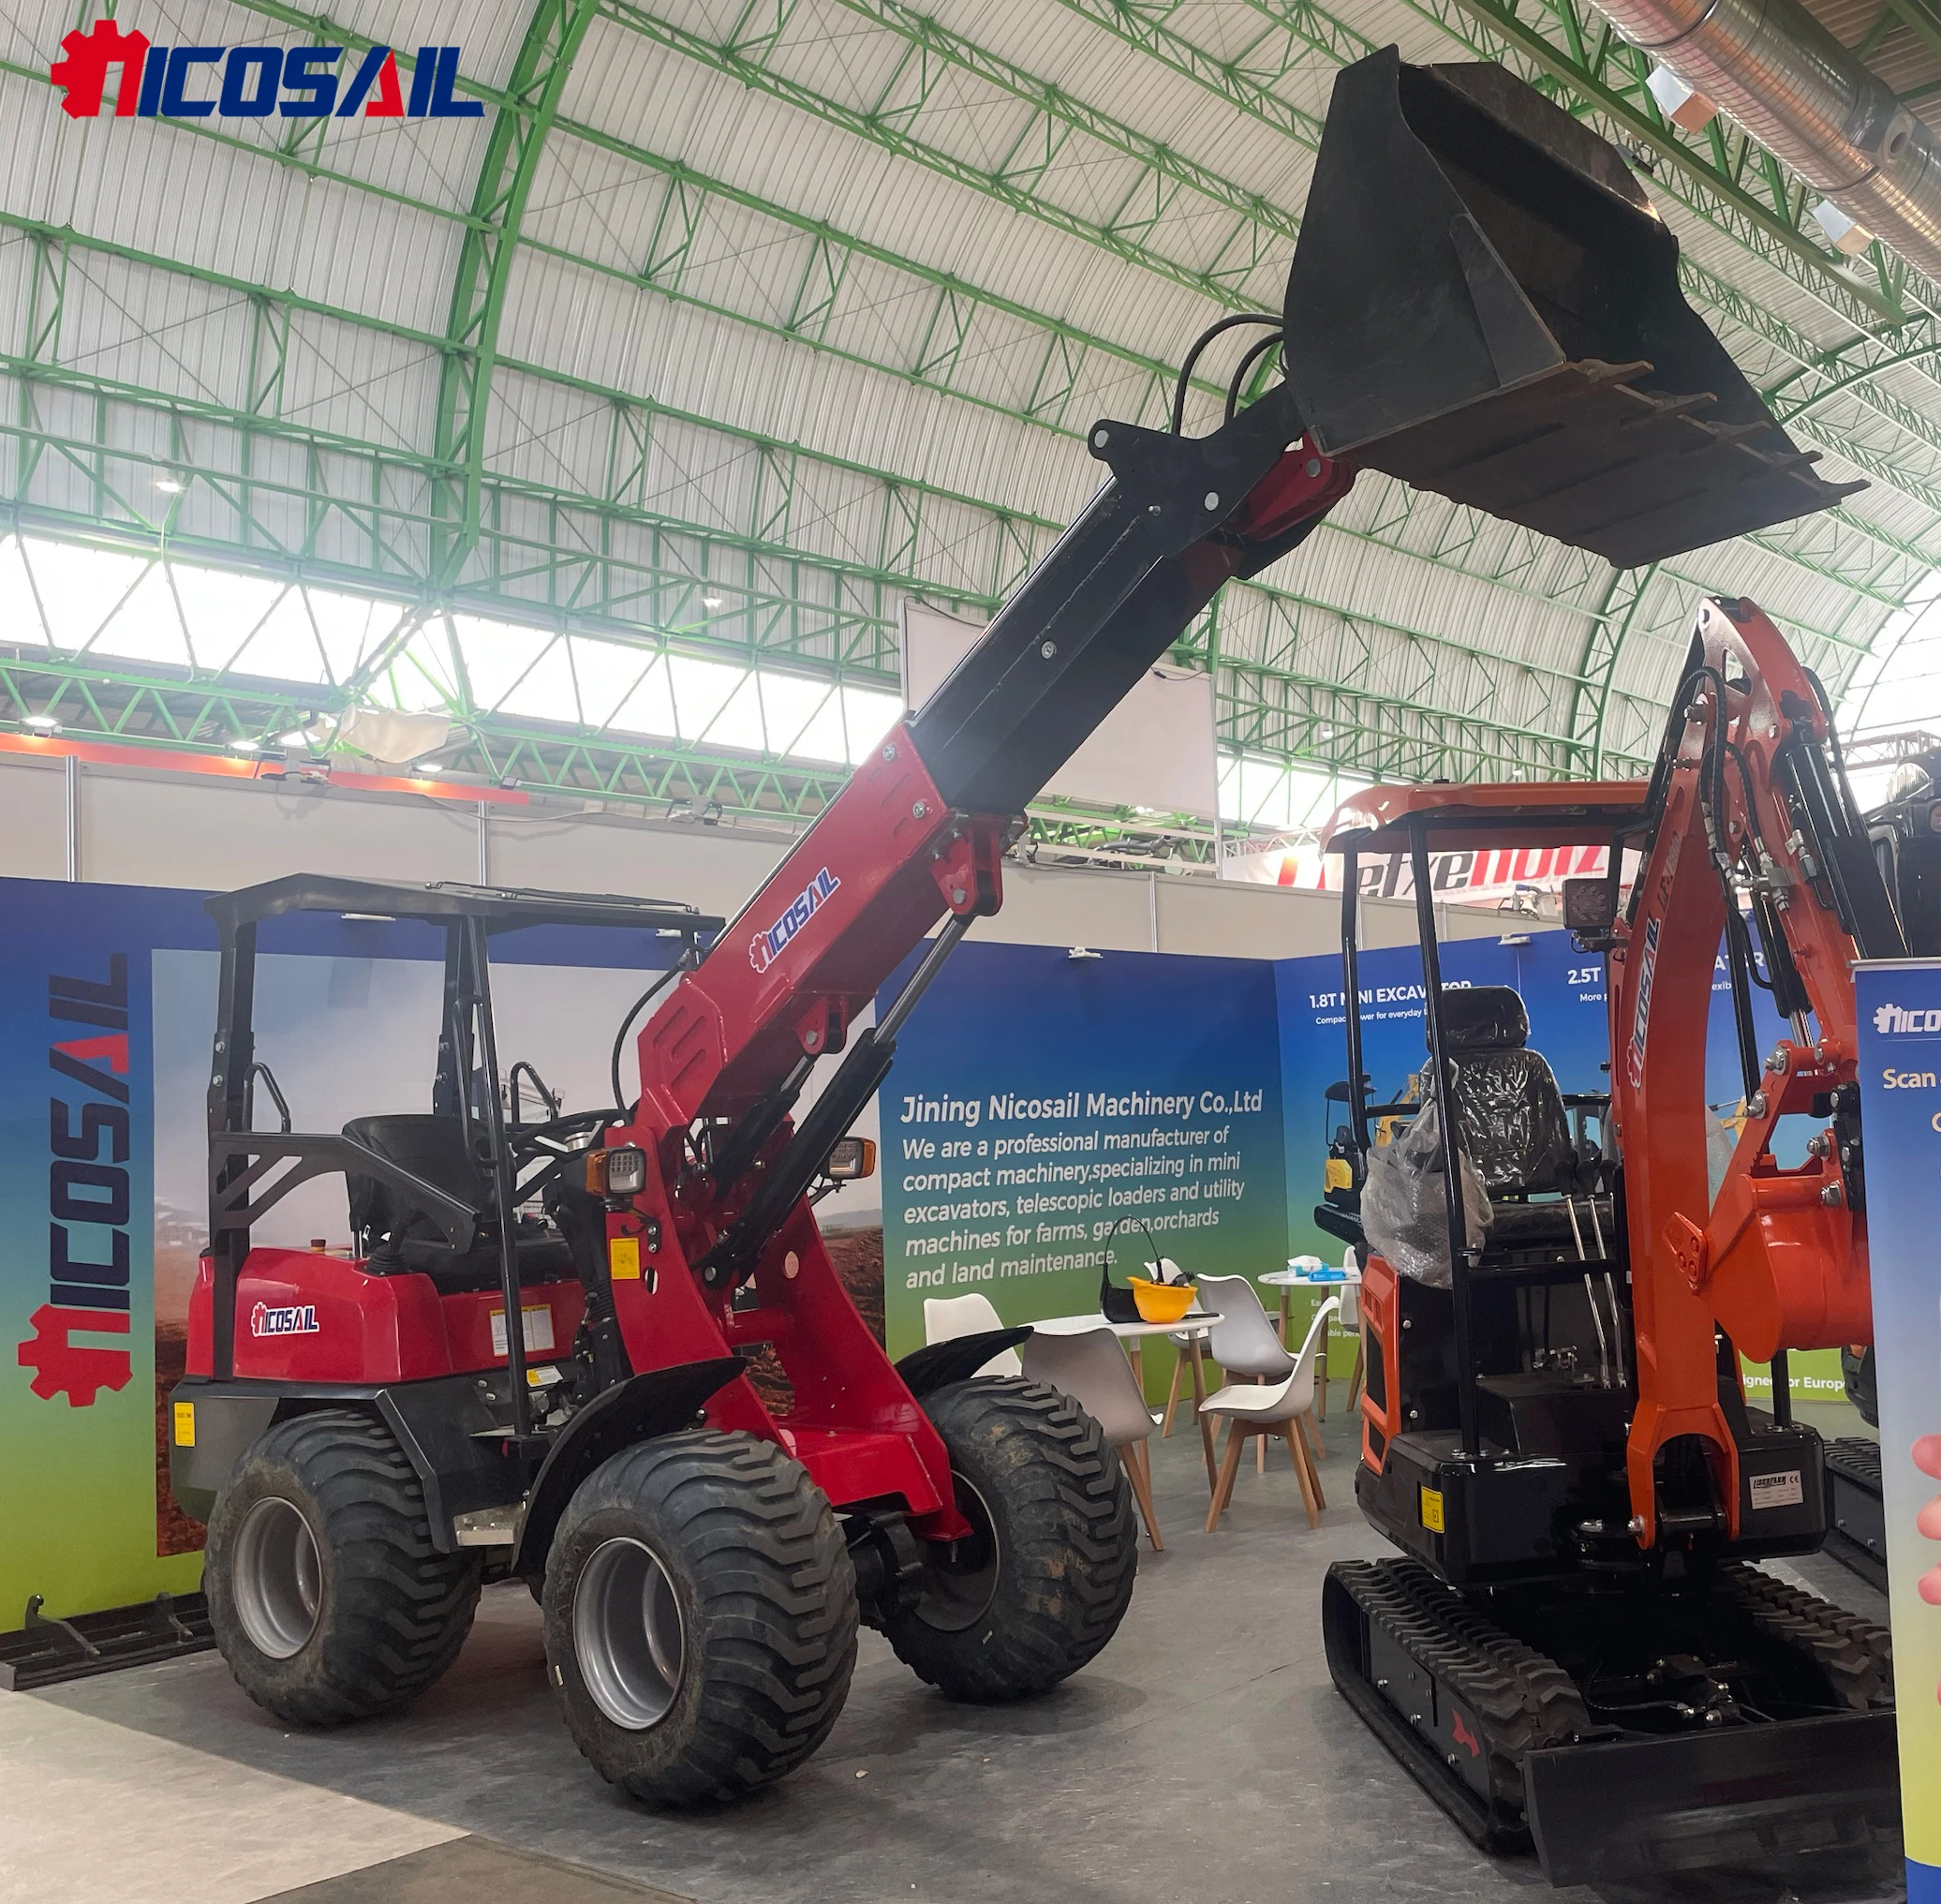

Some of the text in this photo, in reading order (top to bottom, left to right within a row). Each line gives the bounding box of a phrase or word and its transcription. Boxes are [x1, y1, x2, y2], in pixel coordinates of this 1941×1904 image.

[1567, 966, 1602, 985] 2.5T
[1309, 992, 1338, 1009] 1.8T
[1579, 992, 1602, 1002] More
[1315, 1016, 1348, 1025] Compac
[1376, 1011, 1387, 1020] for
[1388, 1008, 1422, 1019] everyday
[1882, 1068, 1936, 1090] Scan
[900, 1093, 981, 1128] Jining
[988, 1093, 1080, 1121] Nicosail
[1086, 1090, 1195, 1120] Machinery
[902, 1124, 1230, 1160] We are a professional manufacturer of
[903, 1168, 992, 1195] compact
[1189, 1153, 1203, 1173] in
[1208, 1151, 1240, 1171] mini
[904, 1178, 1245, 1224] excavators, telescopic loaders and utility
[905, 1228, 1000, 1257] machines
[1006, 1225, 1032, 1246] for
[1036, 1222, 1088, 1243] farms,
[906, 1262, 946, 1289] and
[952, 1257, 995, 1284] land
[1803, 1376, 1845, 1391] Europ
